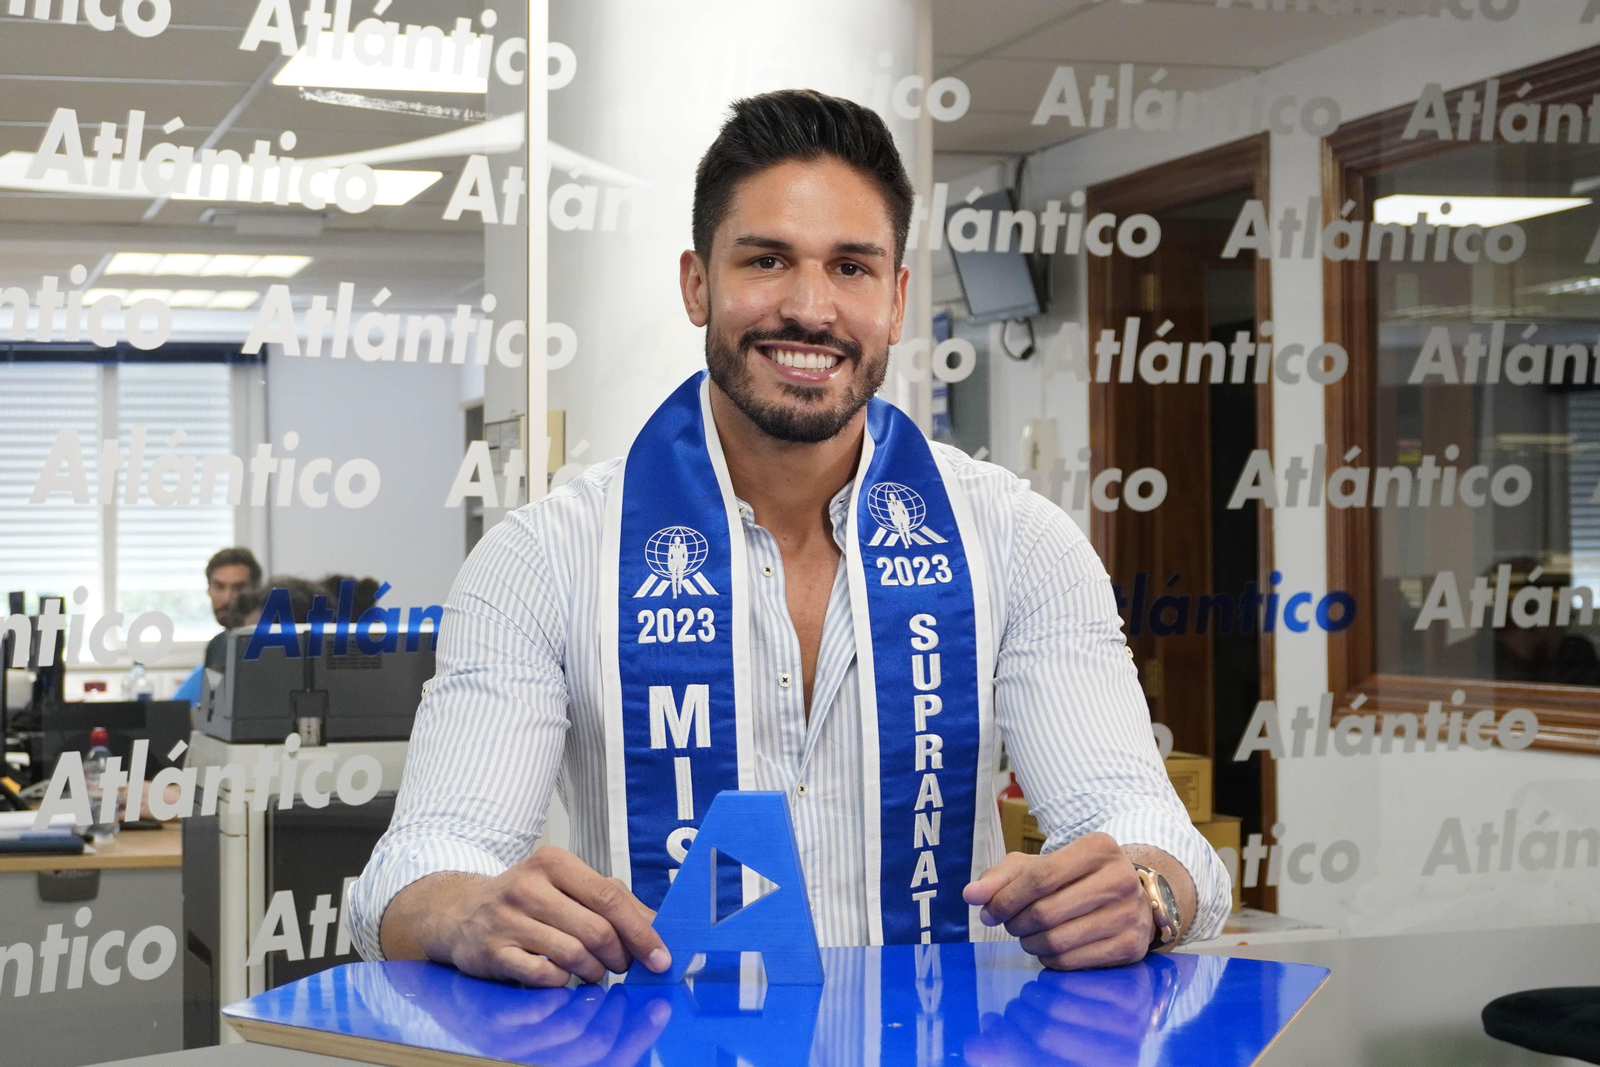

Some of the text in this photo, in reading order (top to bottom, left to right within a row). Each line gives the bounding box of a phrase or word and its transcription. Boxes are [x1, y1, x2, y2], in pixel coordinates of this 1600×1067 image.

[1032, 64, 1341, 136] Atlántico
[25, 107, 378, 213] Atlántico
[1221, 197, 1526, 264] Atlántico
[241, 282, 577, 370] Atlántico
[1045, 317, 1348, 386] Atlántico
[29, 427, 381, 509] Atlántico
[1227, 444, 1533, 510] Atlántico
[876, 554, 953, 587] 2023
[637, 607, 716, 644] 2023
[1233, 690, 1539, 762] Atlántico
[32, 733, 383, 830] Atlántico
